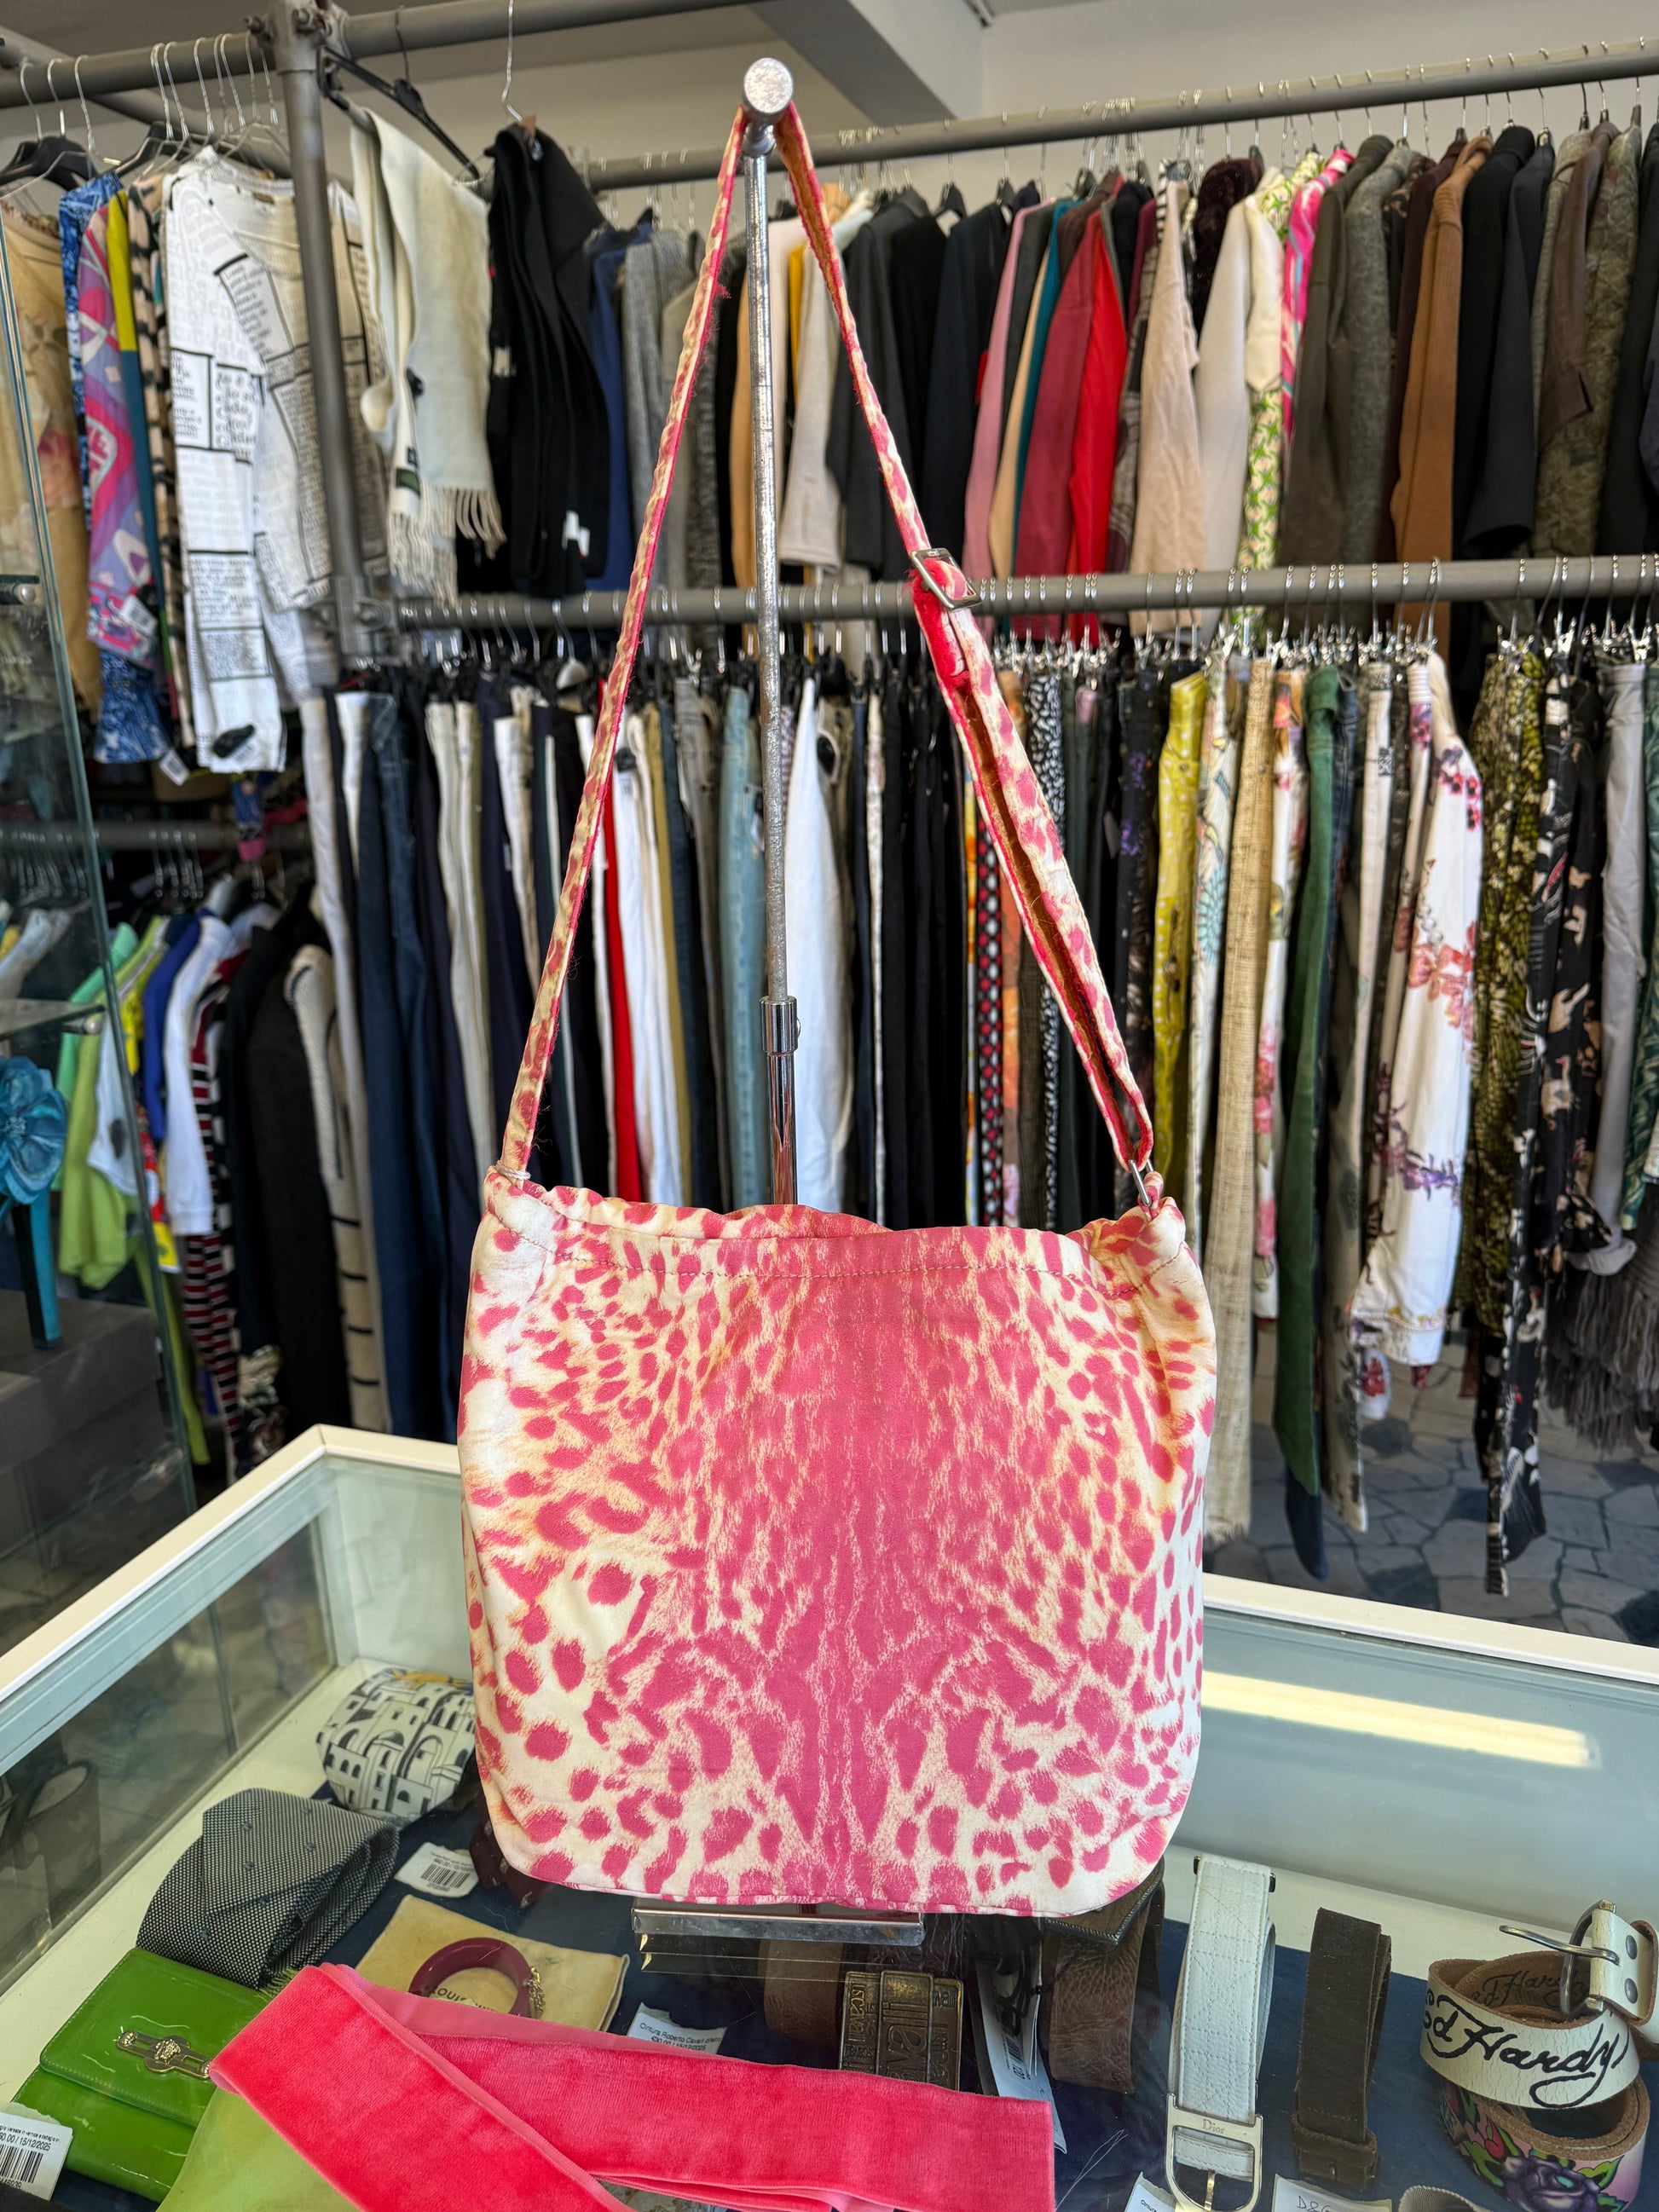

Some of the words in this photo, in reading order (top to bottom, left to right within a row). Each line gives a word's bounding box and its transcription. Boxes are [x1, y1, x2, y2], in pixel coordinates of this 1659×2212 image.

[432, 1988, 467, 2002] OUI
[1427, 1995, 1620, 2109] Hardy
[1202, 2118, 1225, 2134] Dior
[20, 2137, 51, 2151] 15/12/2025
